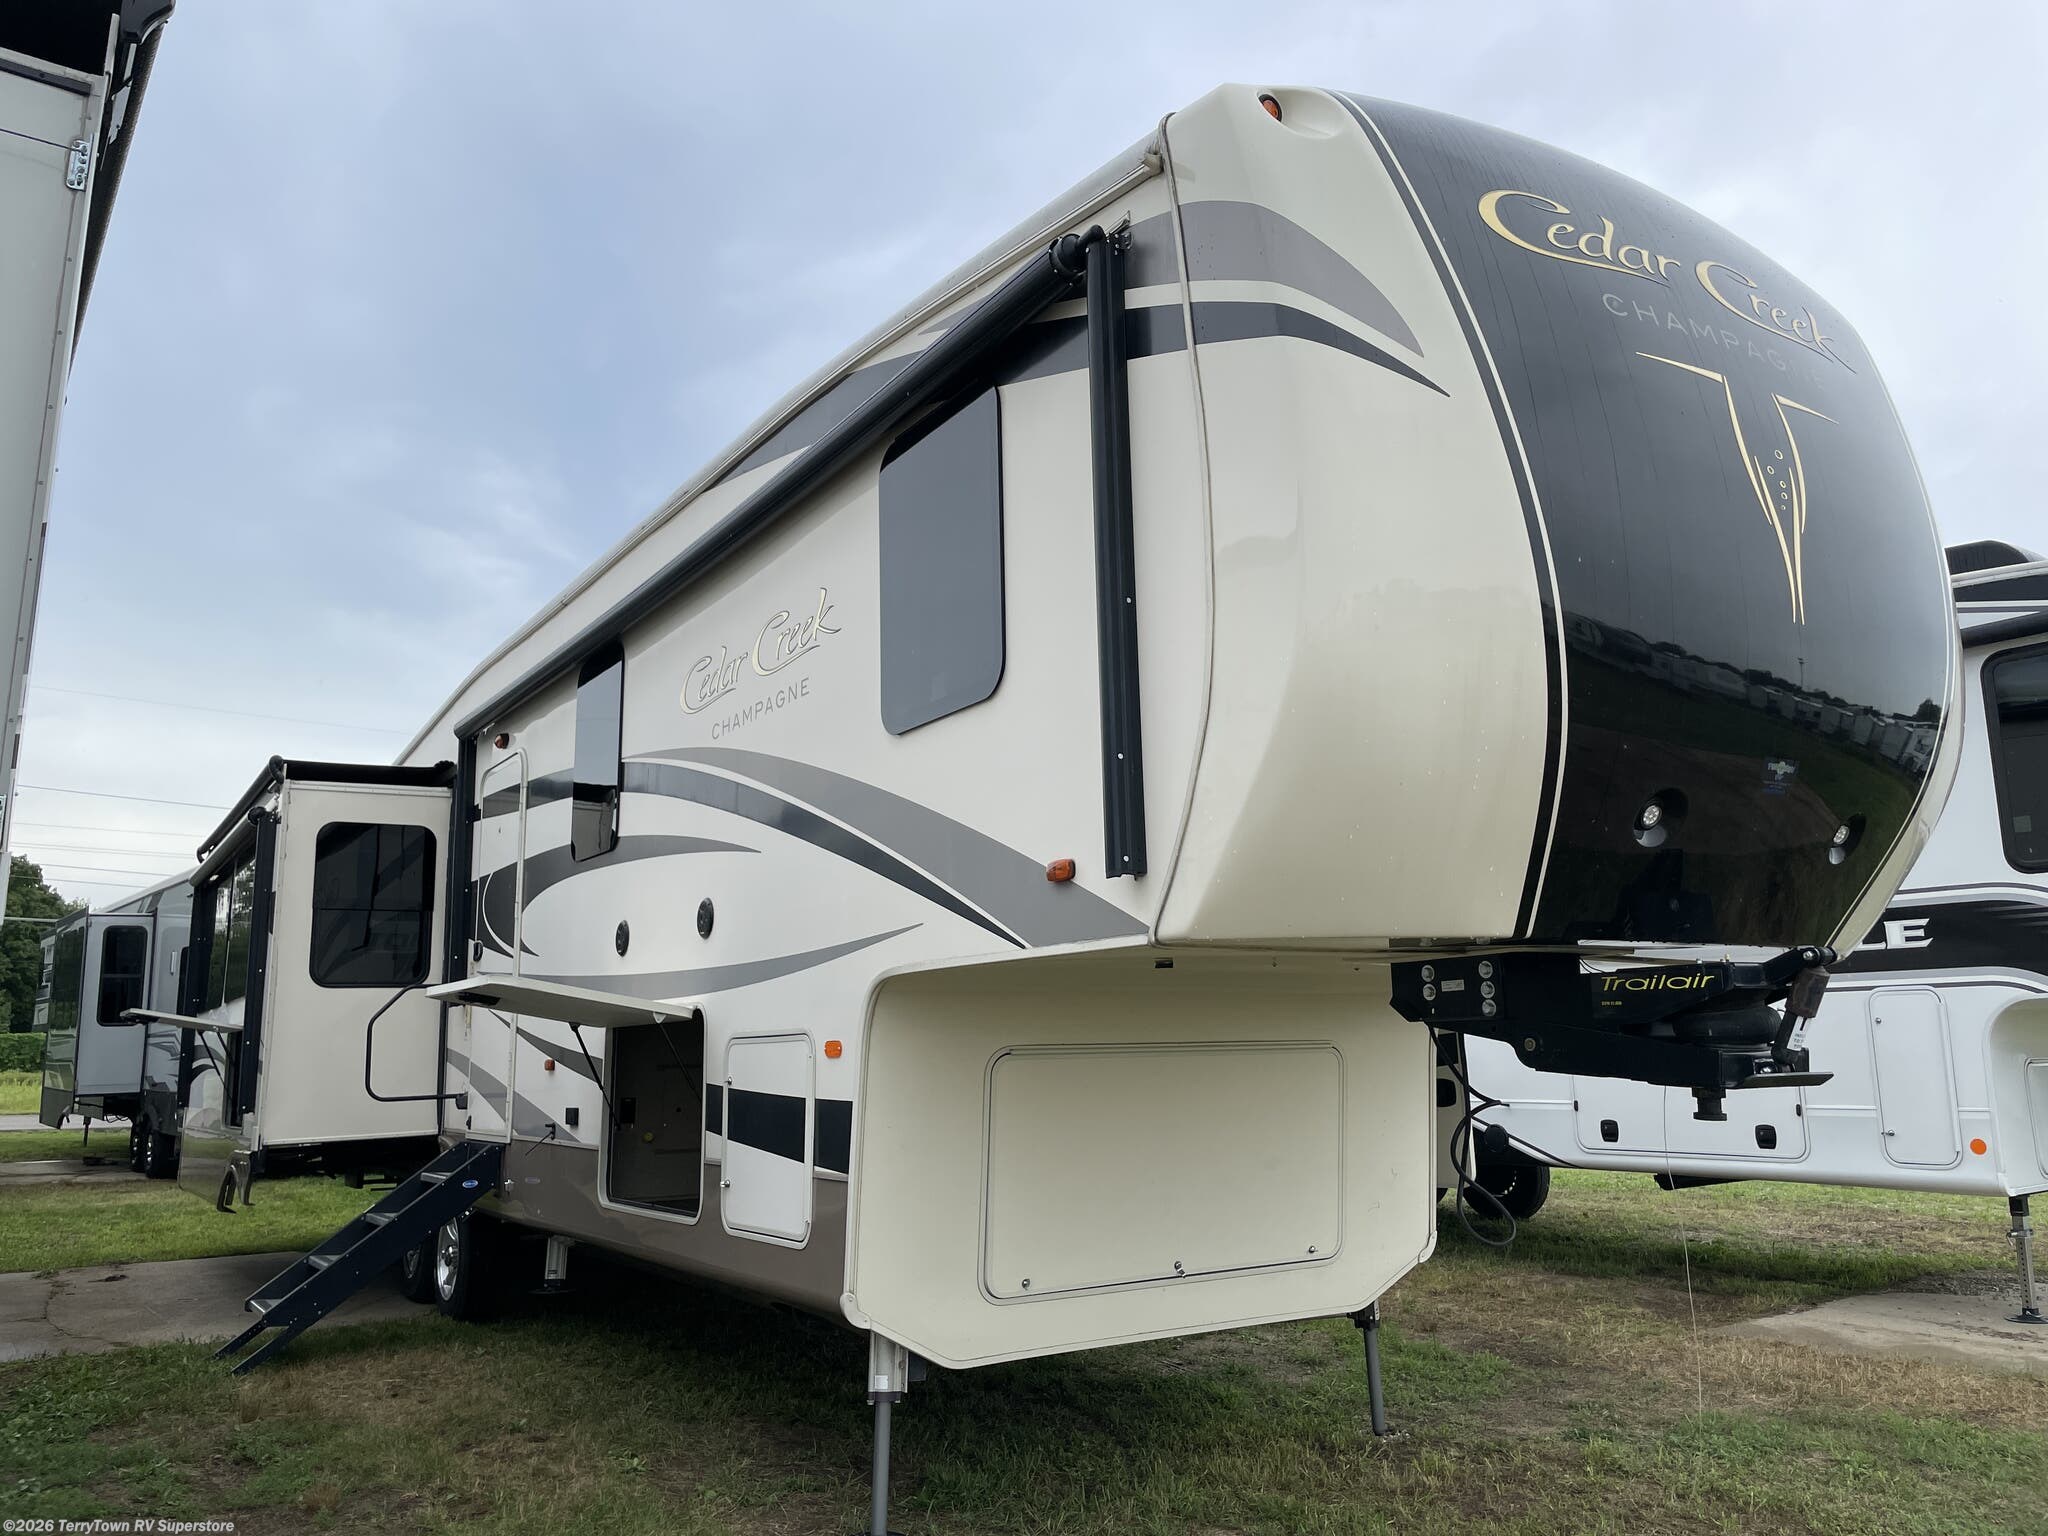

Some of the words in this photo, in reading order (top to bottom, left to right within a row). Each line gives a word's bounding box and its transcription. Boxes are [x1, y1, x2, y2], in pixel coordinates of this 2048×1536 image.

[1478, 189, 1681, 288] Cedar
[1695, 260, 1857, 374] Creek
[680, 645, 749, 714] Cedar
[752, 587, 842, 676] Creek
[711, 677, 811, 740] CHAMPAGNE
[1601, 973, 1715, 991] Trailair
